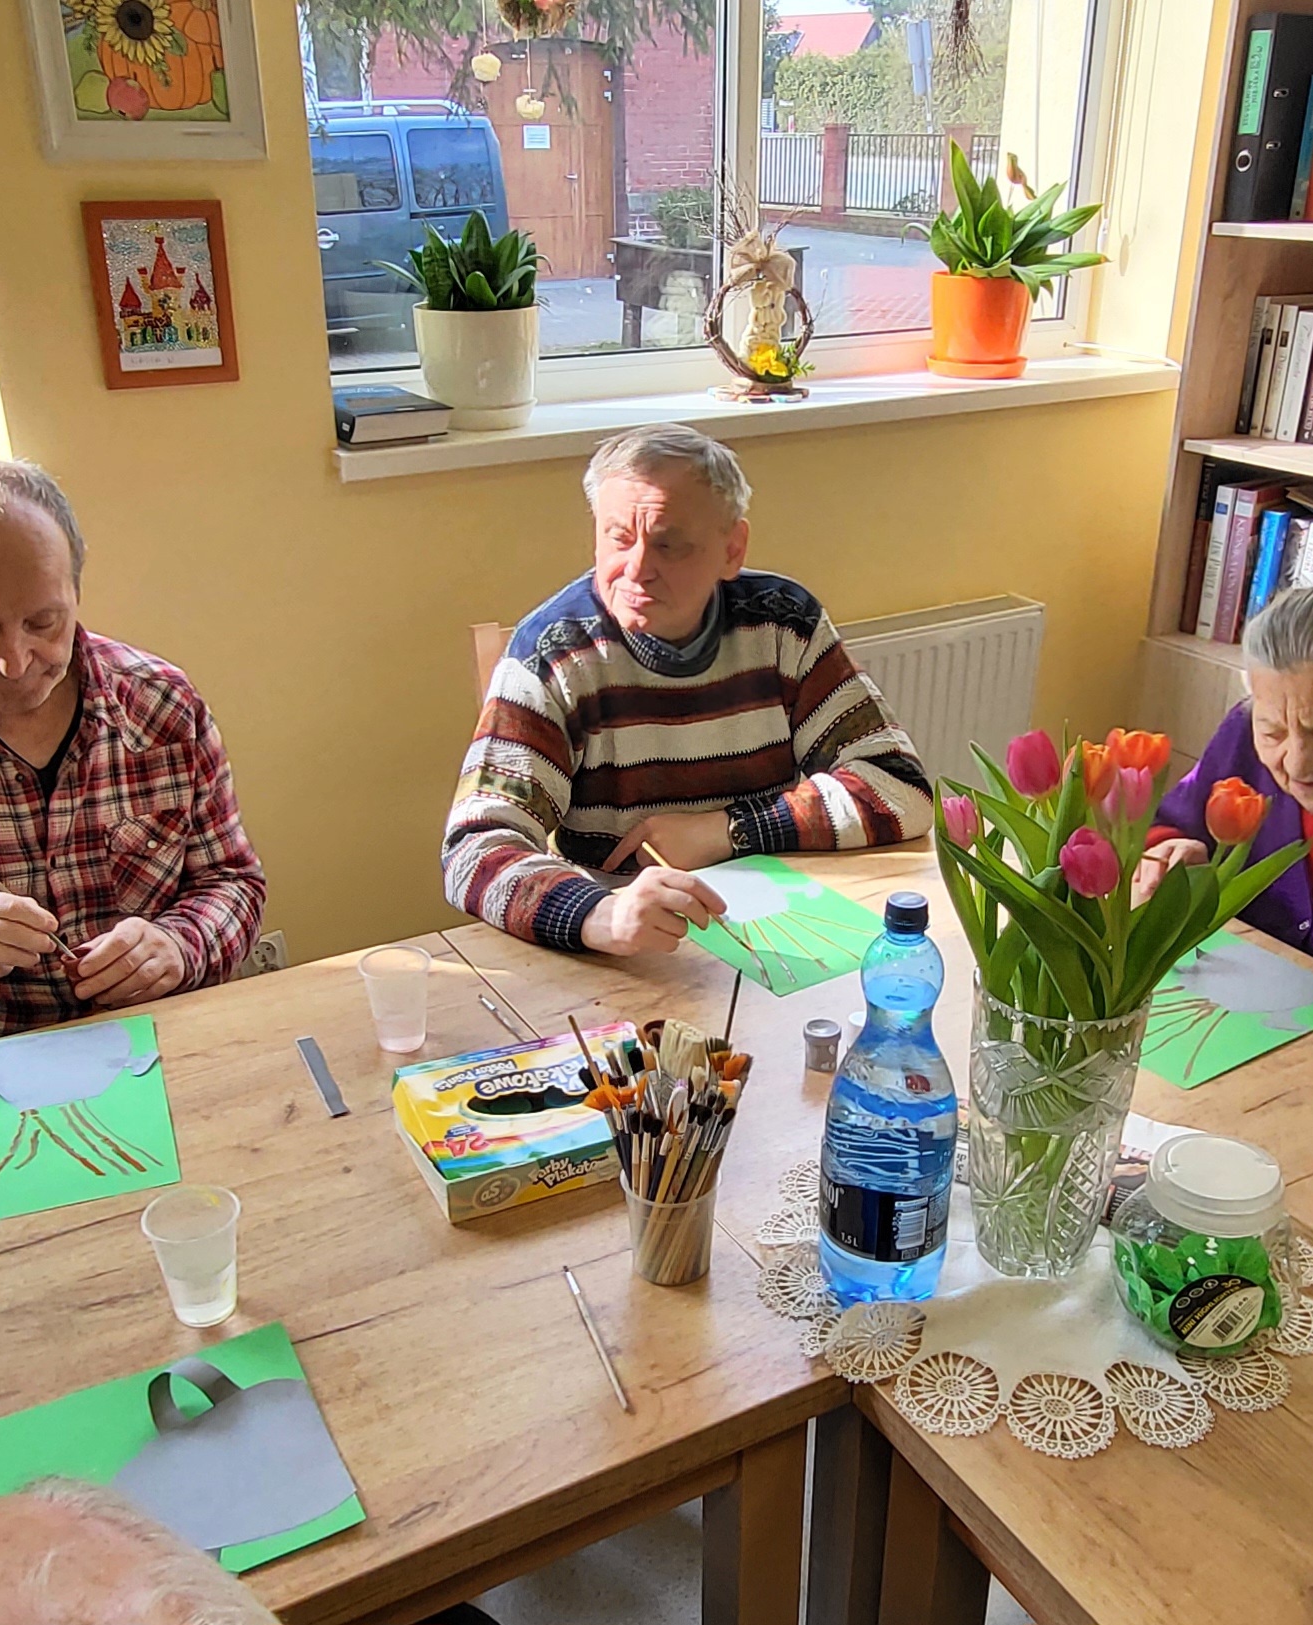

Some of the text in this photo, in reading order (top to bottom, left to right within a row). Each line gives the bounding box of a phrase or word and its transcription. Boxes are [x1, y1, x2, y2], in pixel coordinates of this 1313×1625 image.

[435, 1059, 516, 1091] Poster Paints
[446, 1132, 486, 1158] 24
[544, 1160, 601, 1188] Plakato
